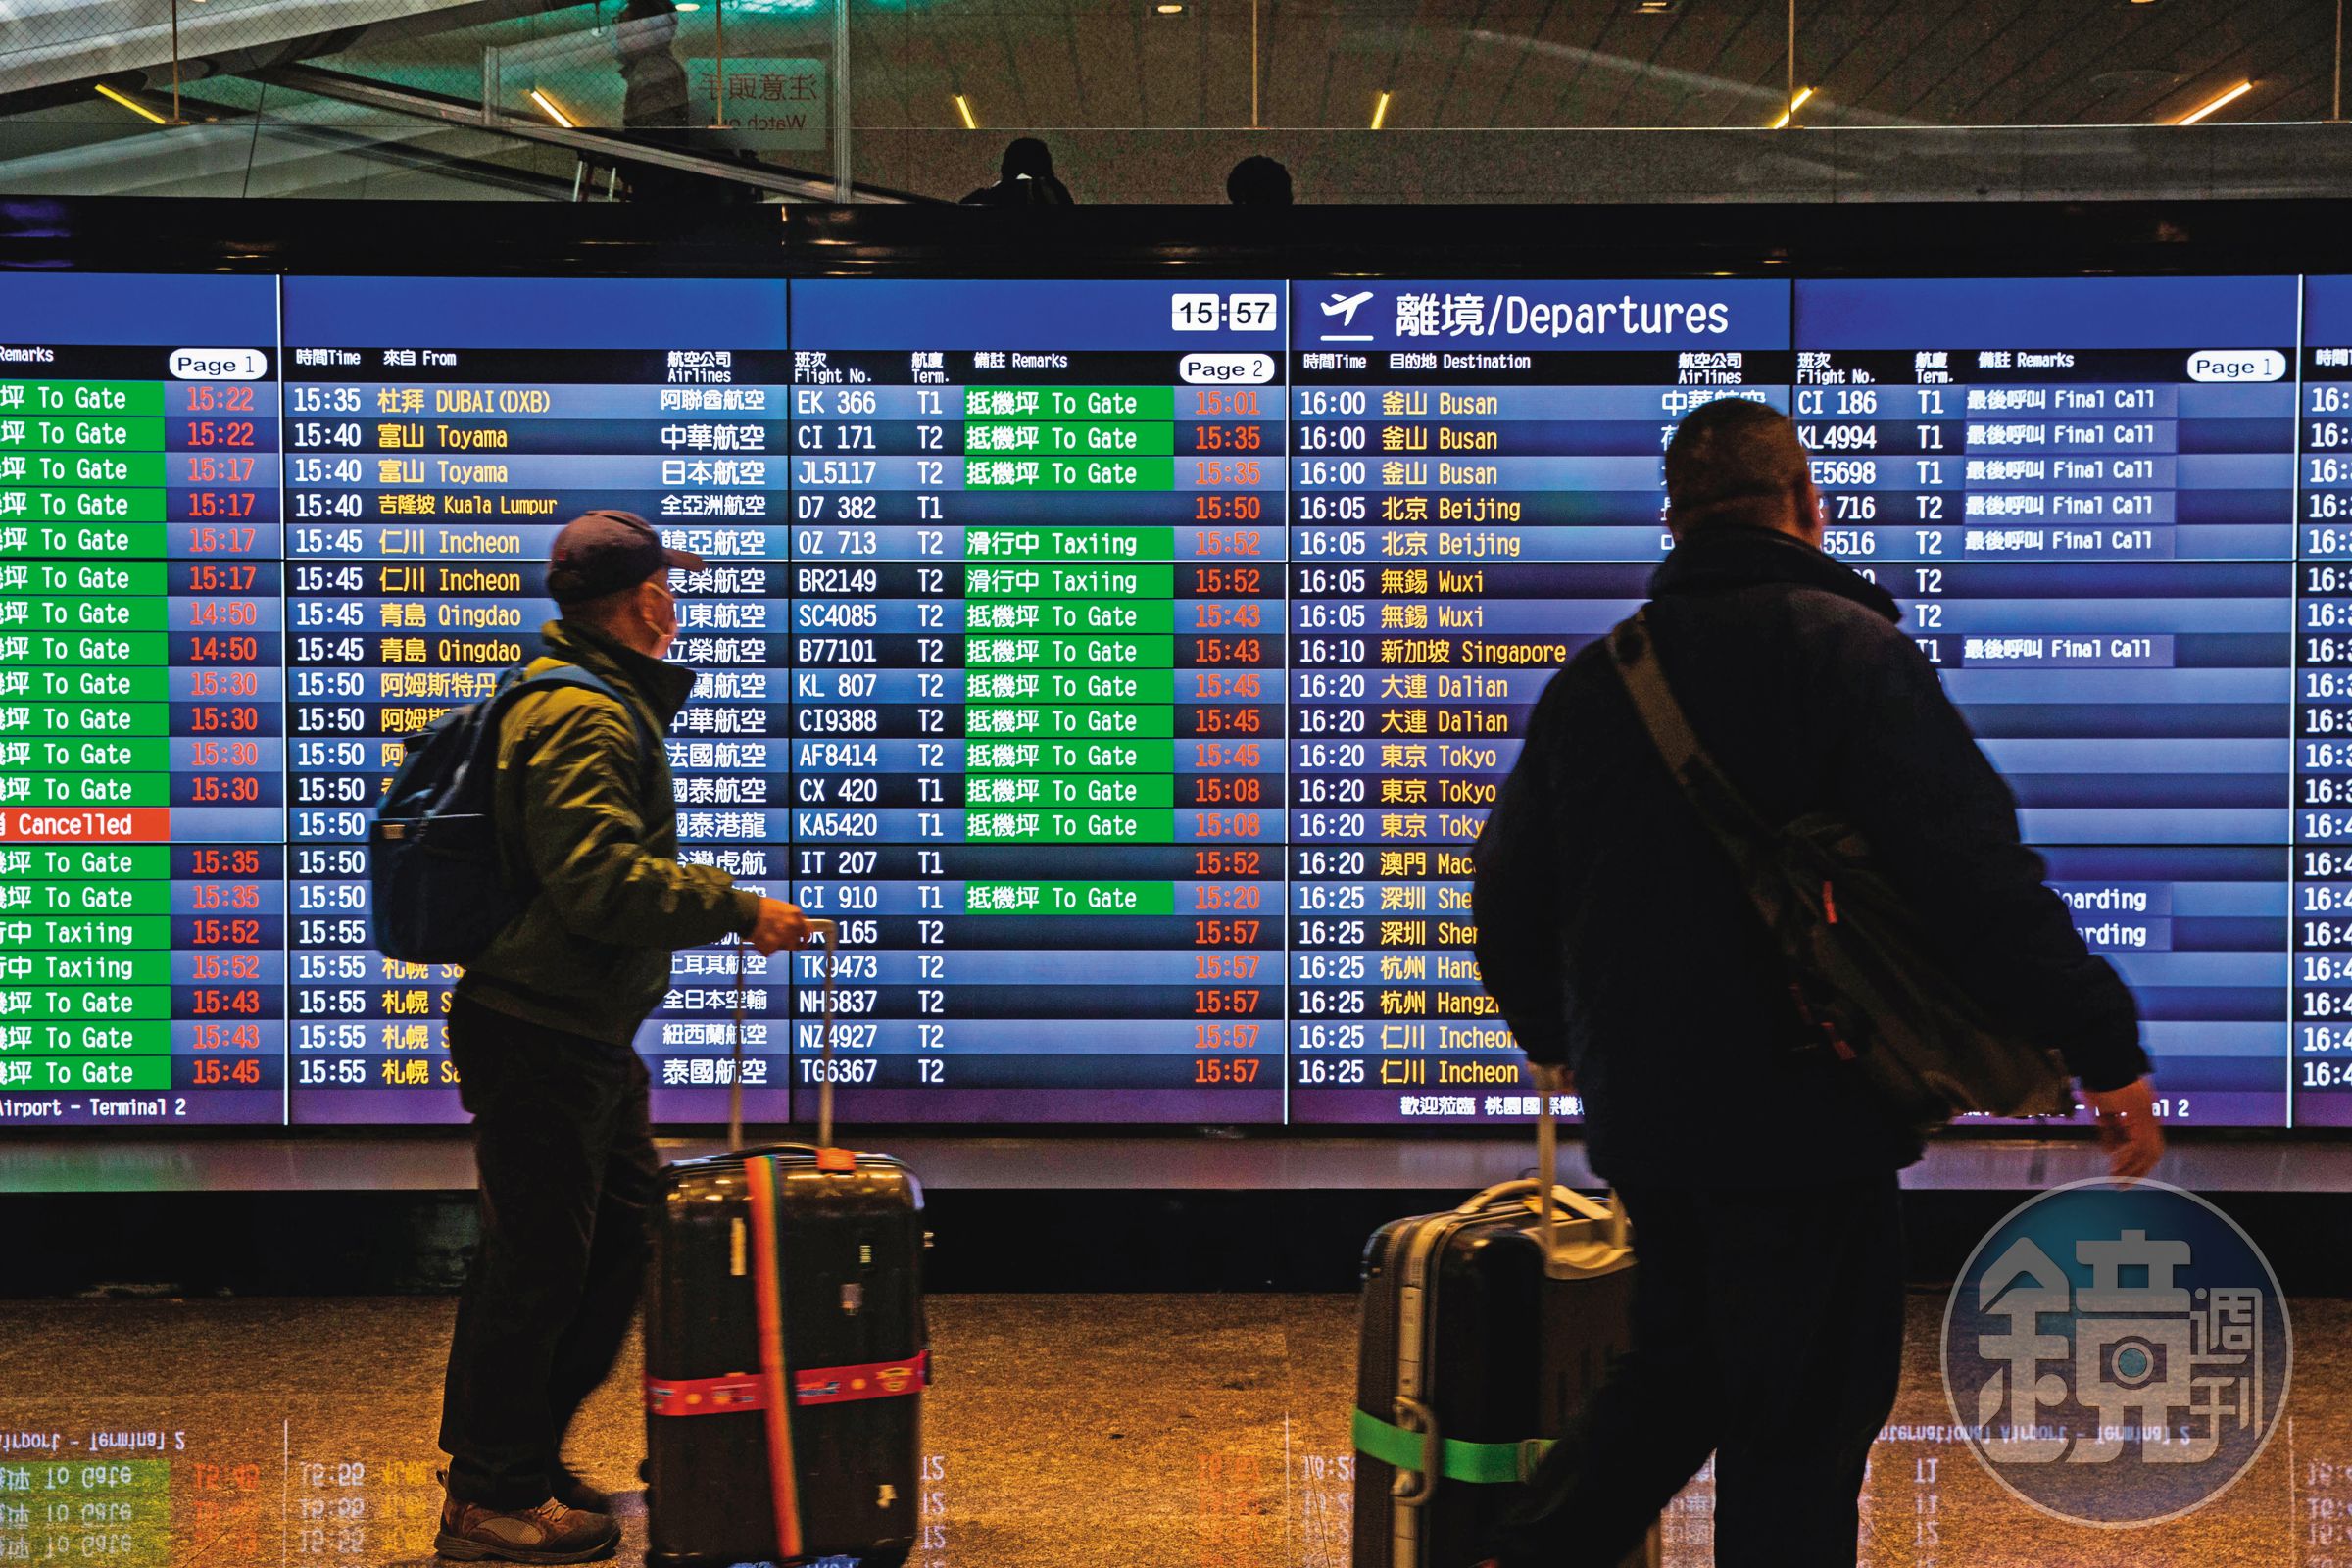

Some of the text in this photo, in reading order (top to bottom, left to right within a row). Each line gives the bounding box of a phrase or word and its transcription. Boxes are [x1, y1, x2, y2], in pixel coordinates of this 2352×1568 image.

[1179, 302, 1270, 324] 15:57
[1396, 293, 1728, 338] 離境/Departures
[177, 356, 255, 376] Page 1
[384, 349, 416, 366] 來自
[423, 351, 456, 365] From
[667, 351, 730, 368] 航空公司
[795, 352, 826, 368] 班次
[974, 352, 1067, 368] 備註 Remarks
[1391, 353, 1437, 369] 目的地
[1444, 354, 1531, 368] Destination
[1679, 352, 1741, 368] 航空公司
[1798, 352, 1831, 368] 班次
[1979, 351, 2075, 368] 備註 Remarks
[2197, 359, 2272, 378] Page 1
[668, 368, 731, 383] Airlines
[795, 368, 871, 385] Flight No.
[912, 368, 950, 383] Term.
[1188, 360, 1263, 380] Page 2
[1679, 369, 1741, 384] Airlines
[1798, 369, 1875, 385] Flight No.
[1916, 369, 1953, 384] Term.
[38, 387, 63, 408] To
[75, 387, 125, 409] Gate
[188, 386, 254, 411] 15:22
[295, 388, 361, 411] 15:35
[378, 388, 424, 413] 杜拜
[799, 391, 824, 414] EK
[838, 391, 876, 414] 366
[917, 391, 942, 414] T1
[967, 391, 1039, 415] 抵機坪
[1052, 392, 1076, 414] To
[1088, 392, 1137, 414] Gate
[1196, 391, 1259, 415] 15:01
[1301, 390, 2153, 415] 16:00 釜山 Busan CI 186 T1 最後呼叫 Final Call
[378, 423, 942, 450] 富山 Toyama 中華航空 CI 171 T2
[1798, 425, 1943, 449] KL4994 T1
[662, 460, 876, 485] 日本航空 JL5117
[189, 493, 255, 516] 15:17
[378, 494, 1260, 519] 吉隆坡 Kuala Lumpur 全亞洲航空 D7 382 15:50
[1301, 496, 1876, 521] 16:05 北京 Beijing 716
[379, 529, 424, 554] 仁川
[439, 531, 519, 553] Incheon
[838, 531, 876, 554] 713
[967, 532, 1039, 555] 滑行中
[1053, 533, 1137, 556] Taxiing
[1196, 531, 1260, 555] 15:52
[800, 569, 876, 592] BR2149
[1382, 569, 1482, 594] 無錫 Wuxi
[190, 601, 257, 625] 14:50
[800, 604, 876, 626] SC4085
[298, 637, 1260, 663] 15:45 青島 Qingdao B77101 15:43
[1300, 639, 2150, 664] 16:10 新加坡 Singapore 最後呼叫 Final Call
[1300, 674, 1507, 698] 16:20 大連 Dalian
[192, 708, 257, 730] 15:30
[800, 710, 876, 731] CI9388
[800, 744, 877, 766] AF8414
[1381, 744, 1427, 768] 東京
[19, 813, 131, 835] Cancelled
[800, 813, 1259, 837] KA5420 抵機坪 To Gate 15:08
[1196, 851, 1260, 875] 15:52
[1299, 852, 1426, 875] 16:20 澳門
[1300, 886, 1426, 910] 16:25 深圳
[46, 922, 132, 945] Taxiing
[1380, 955, 1425, 980] 杭州
[46, 1059, 259, 1084] To Gate 15:45
[300, 1058, 1259, 1084] 15:55 札幌 T2 15:57
[1299, 1059, 1518, 1084] 16:25 仁川 Incheon
[90, 1099, 166, 1116] Terminal
[175, 1098, 186, 1115] 2
